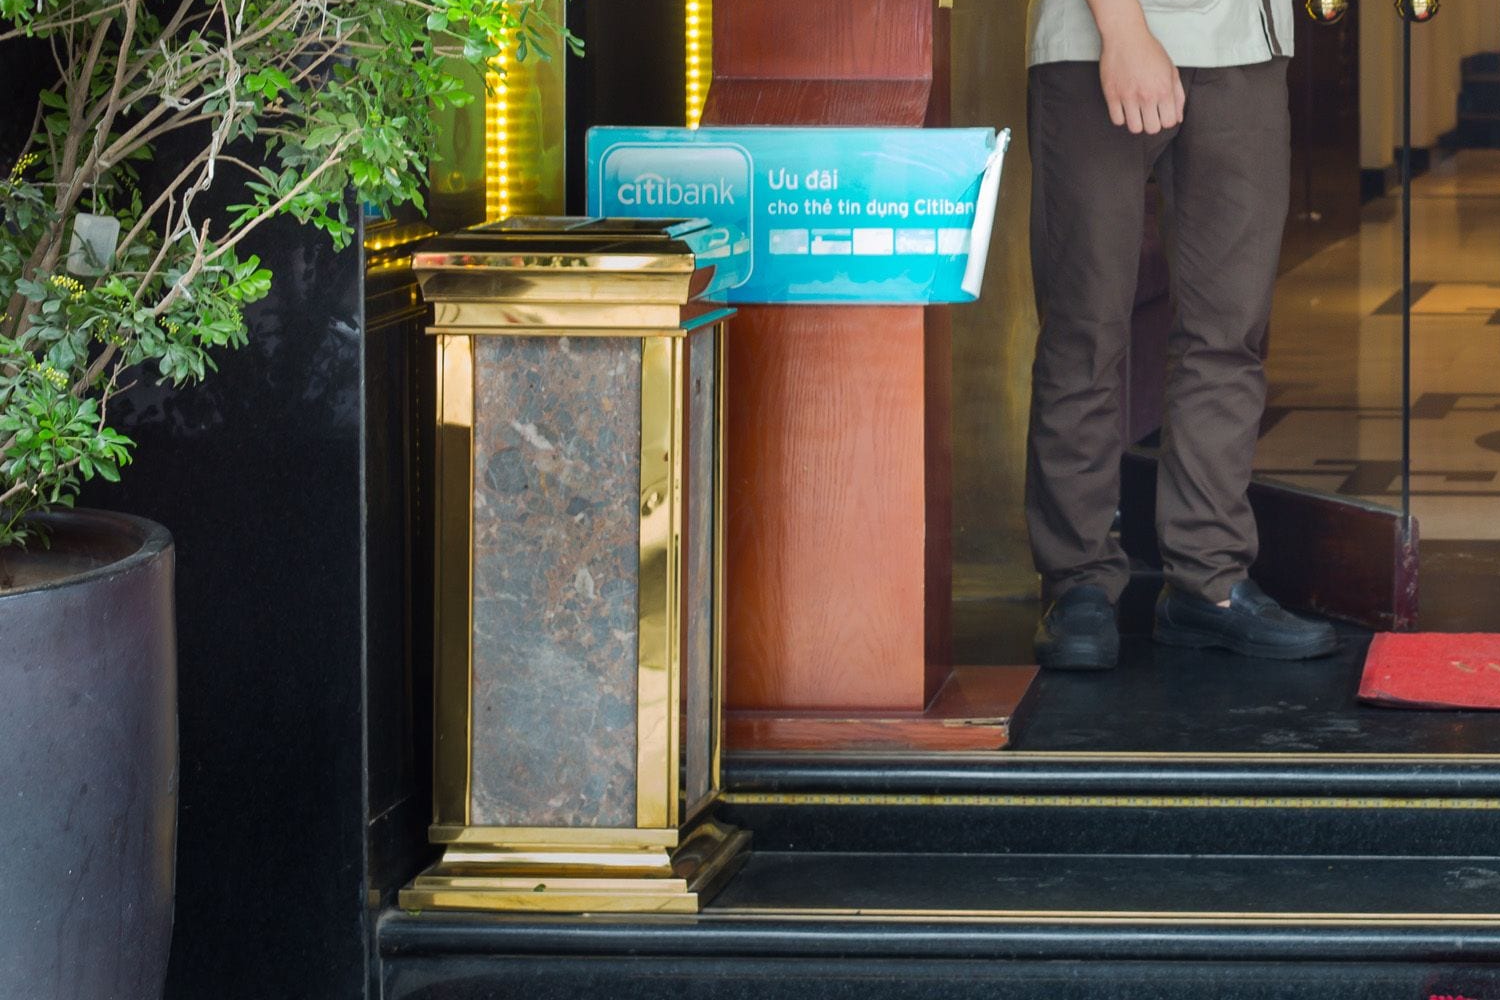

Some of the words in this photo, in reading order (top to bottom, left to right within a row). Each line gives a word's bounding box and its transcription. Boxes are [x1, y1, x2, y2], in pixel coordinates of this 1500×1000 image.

[617, 172, 734, 205] citibank
[768, 200, 798, 215] cho
[866, 199, 909, 218] dụng
